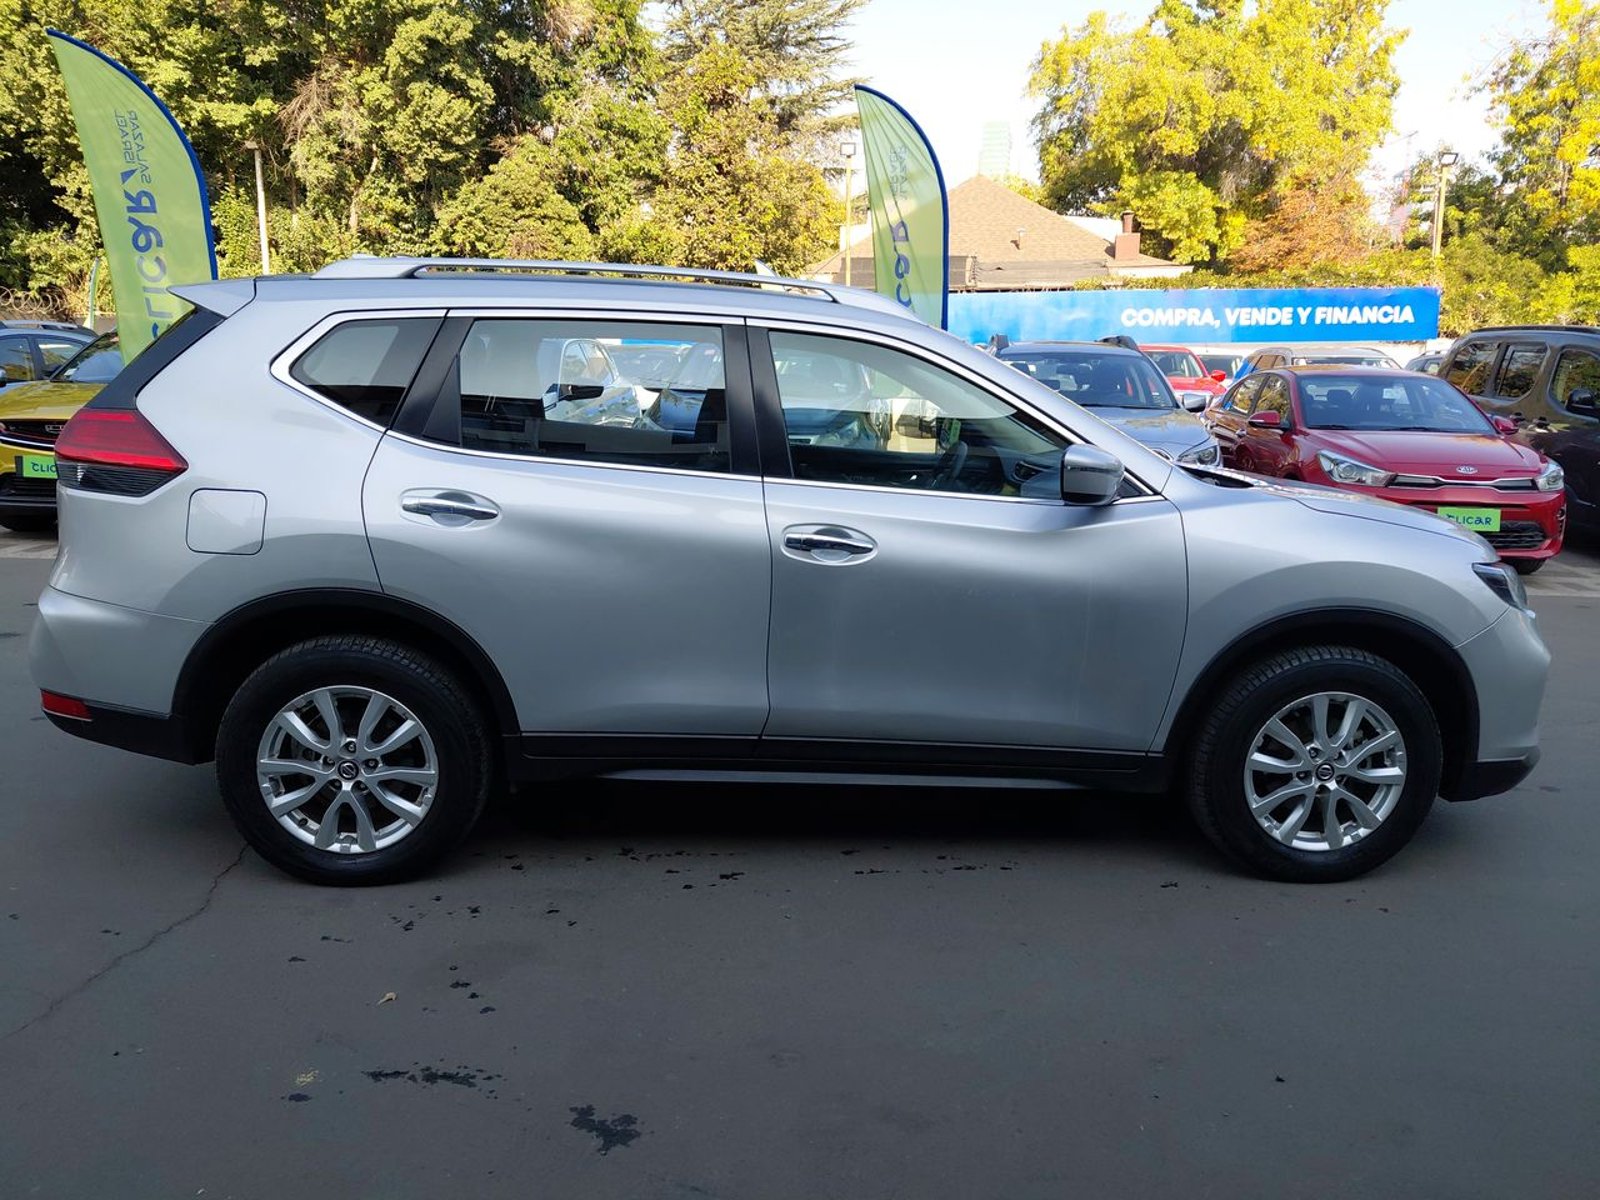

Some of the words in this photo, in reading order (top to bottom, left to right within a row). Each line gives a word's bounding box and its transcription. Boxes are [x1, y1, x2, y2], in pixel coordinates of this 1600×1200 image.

[1121, 307, 1221, 328] COMPRA,
[1224, 306, 1293, 326] VENDE
[1296, 306, 1312, 325] Y
[1314, 304, 1415, 325] FINANCIA
[31, 461, 57, 473] CLIC
